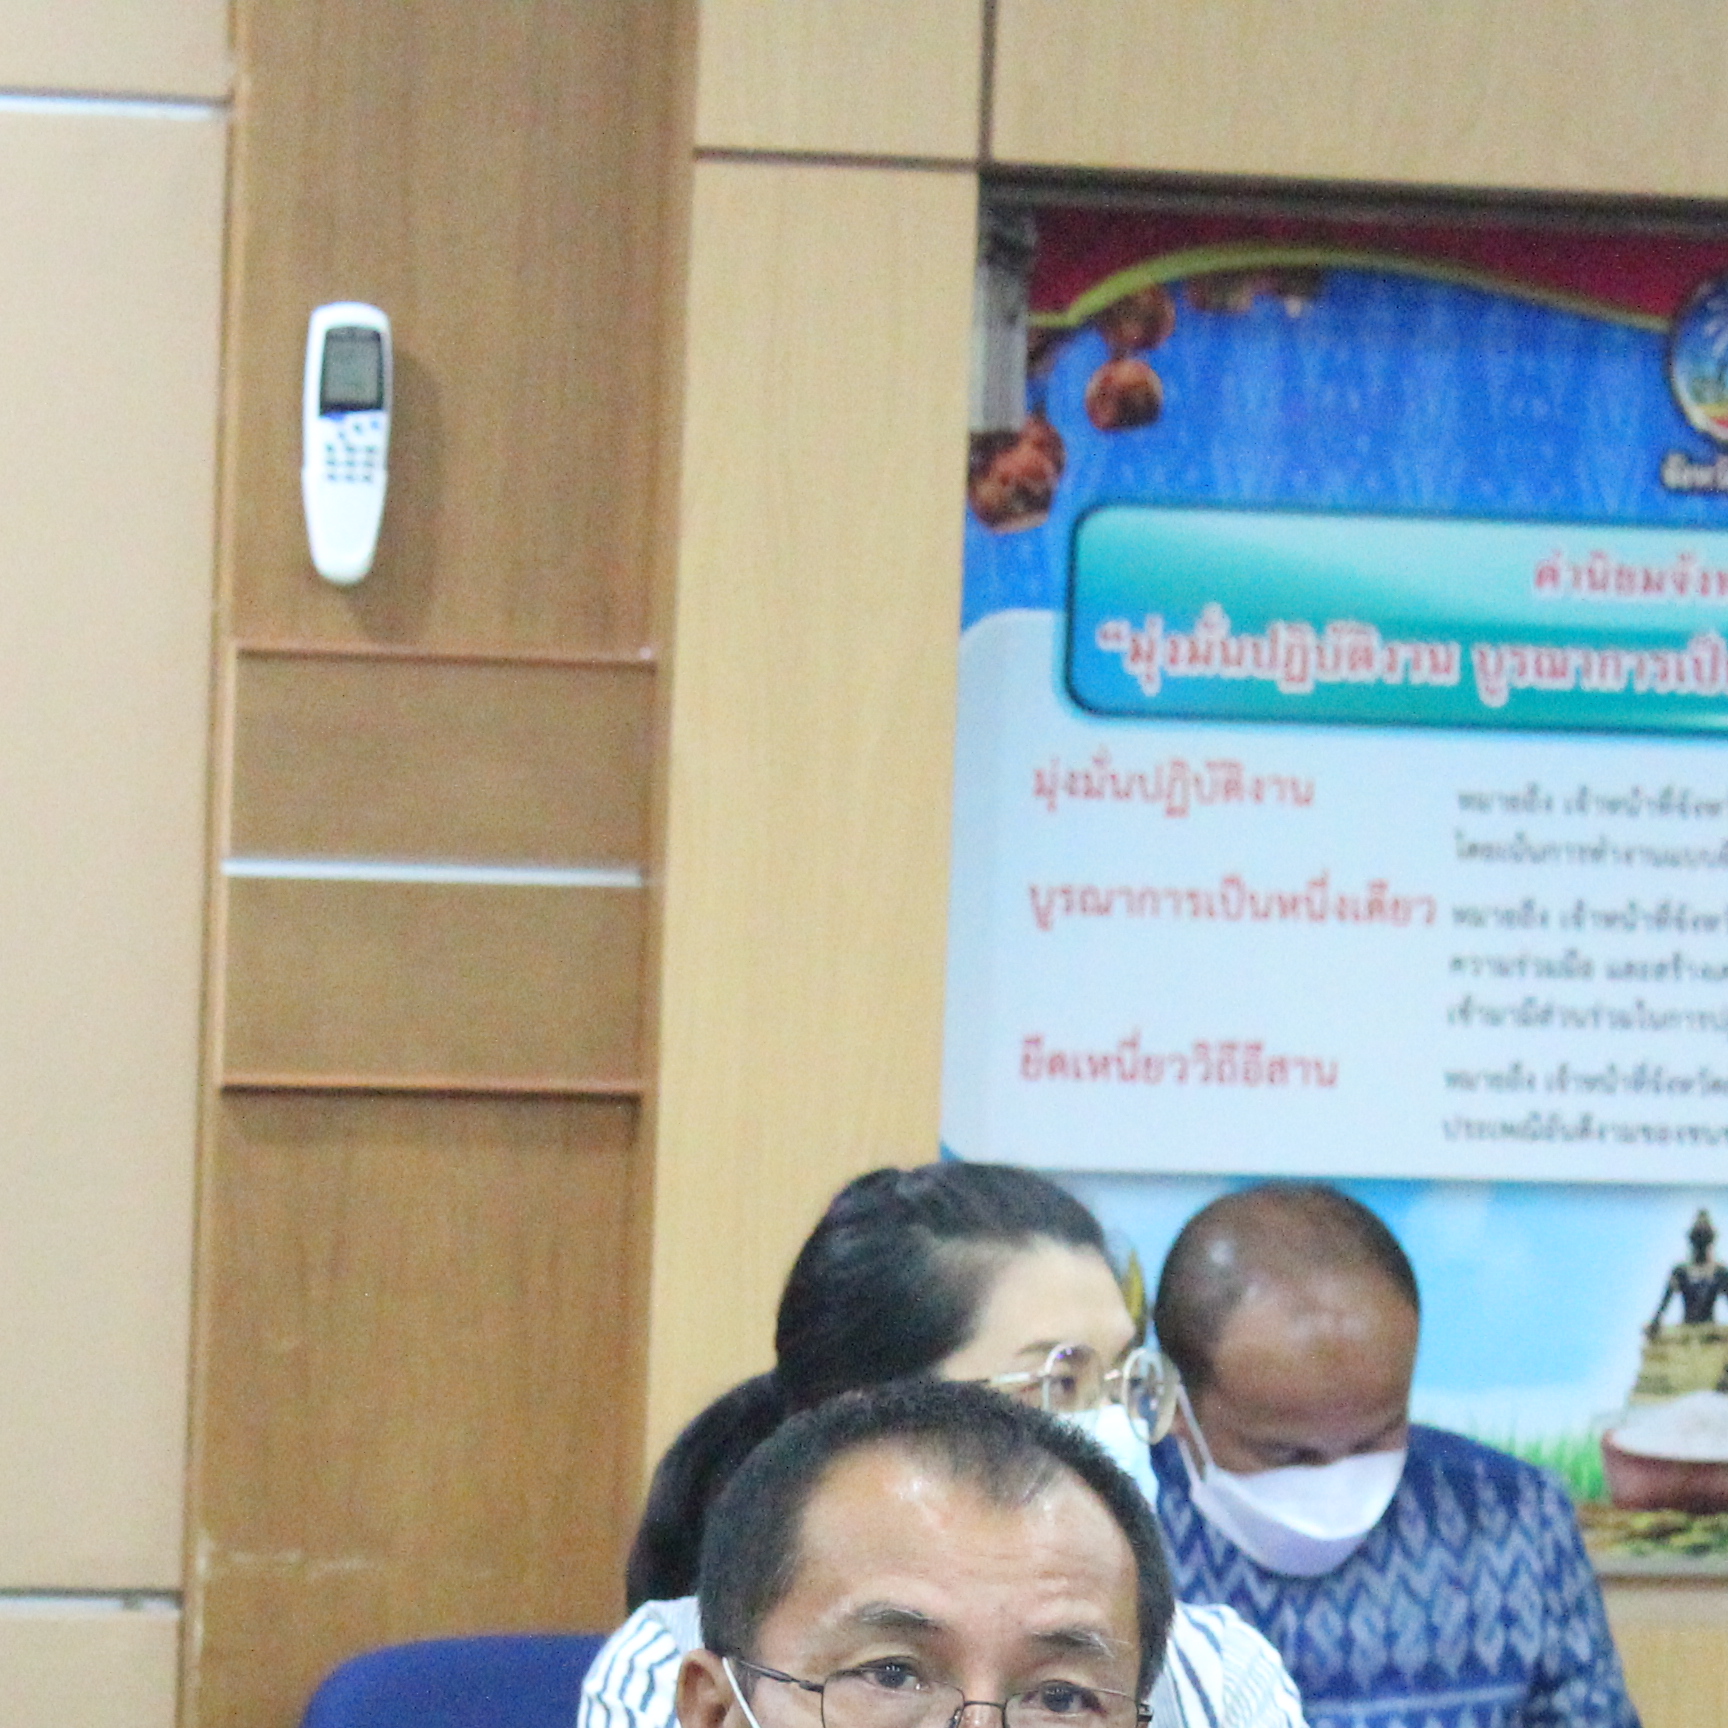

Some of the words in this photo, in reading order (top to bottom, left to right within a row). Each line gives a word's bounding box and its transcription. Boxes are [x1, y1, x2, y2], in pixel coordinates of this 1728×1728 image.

[1033, 744, 1315, 818] มุ่งมั่นปฏิบัติงาน
[1029, 869, 1437, 931] บูรณาการเป็นหนึ่งเดียว
[1020, 1027, 1340, 1088] ยึดเหนี่ยววิถีอีสาน
